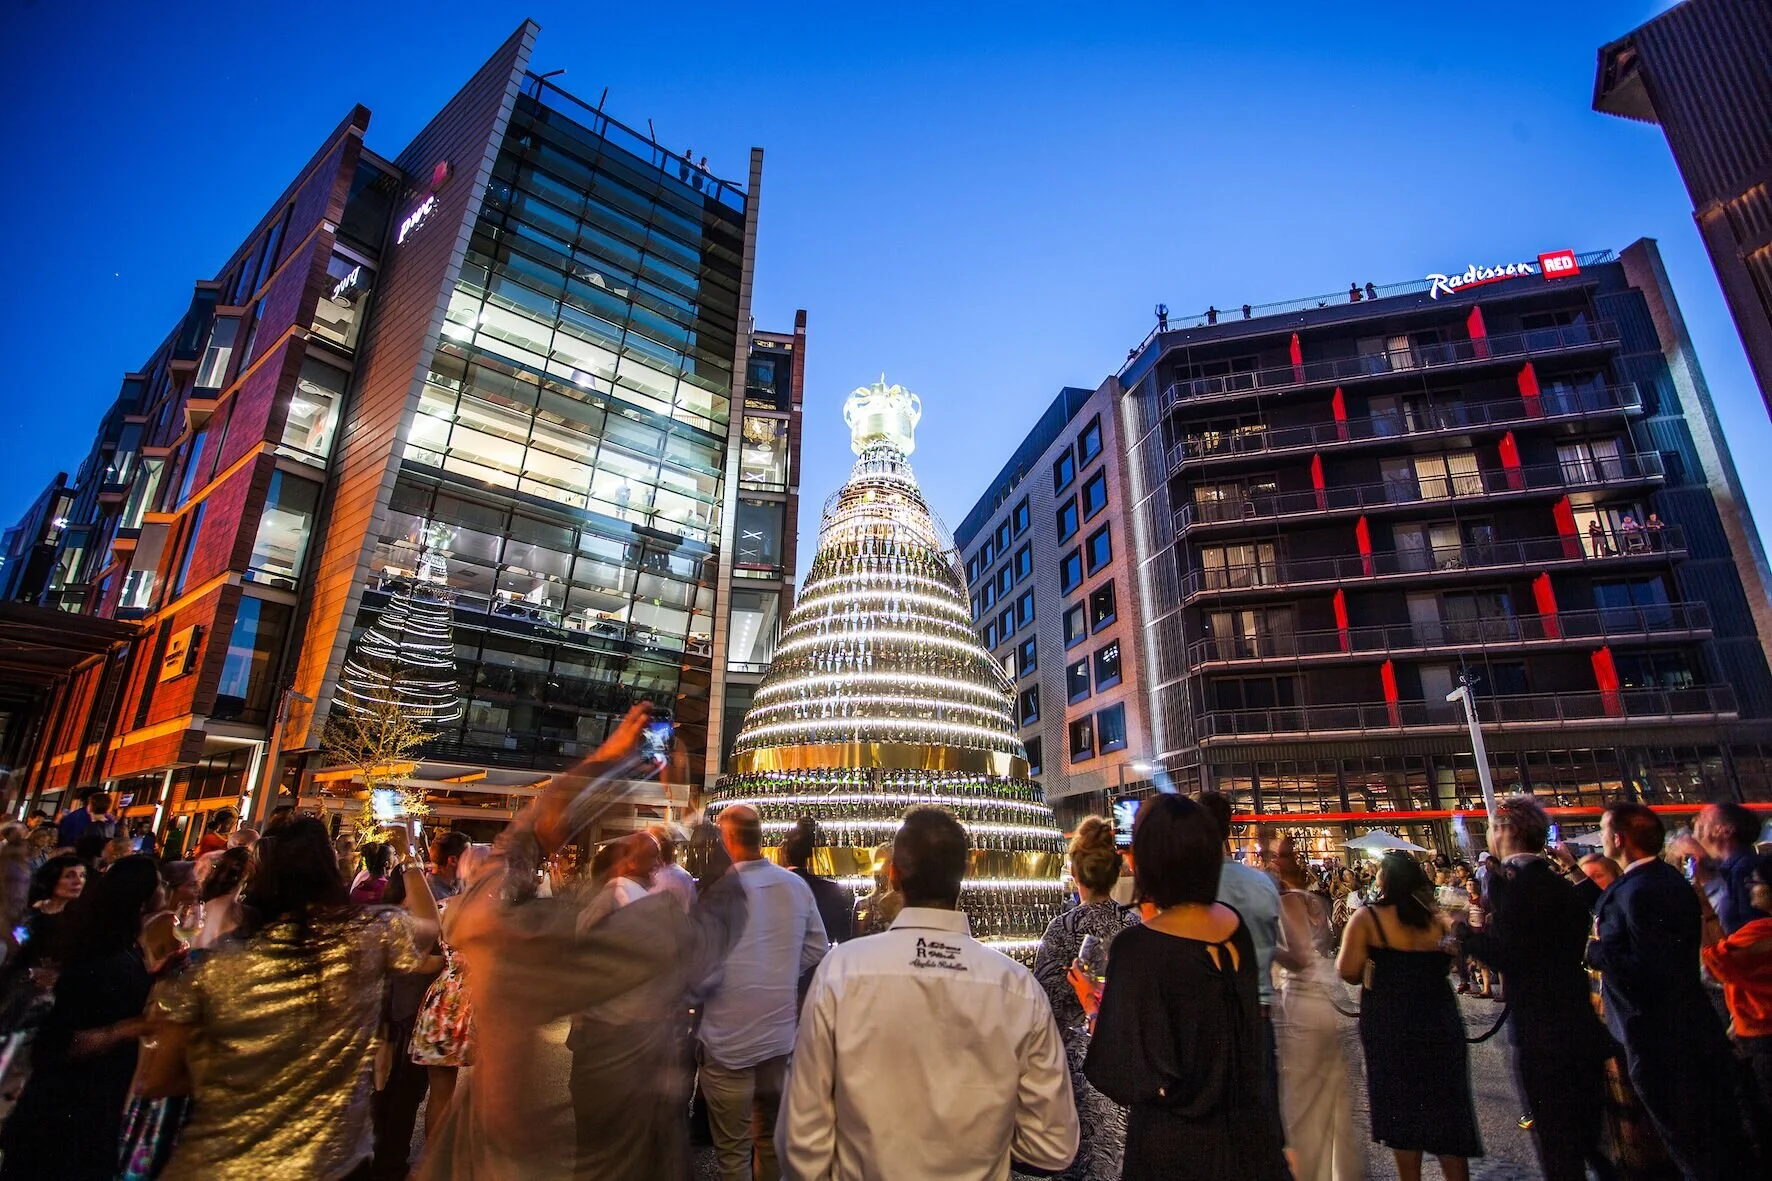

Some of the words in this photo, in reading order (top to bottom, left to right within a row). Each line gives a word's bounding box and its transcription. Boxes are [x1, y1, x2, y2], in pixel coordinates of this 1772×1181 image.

[396, 195, 434, 245] pwc
[1425, 262, 1534, 300] Radisson
[1544, 255, 1574, 272] RED
[916, 937, 927, 948] A
